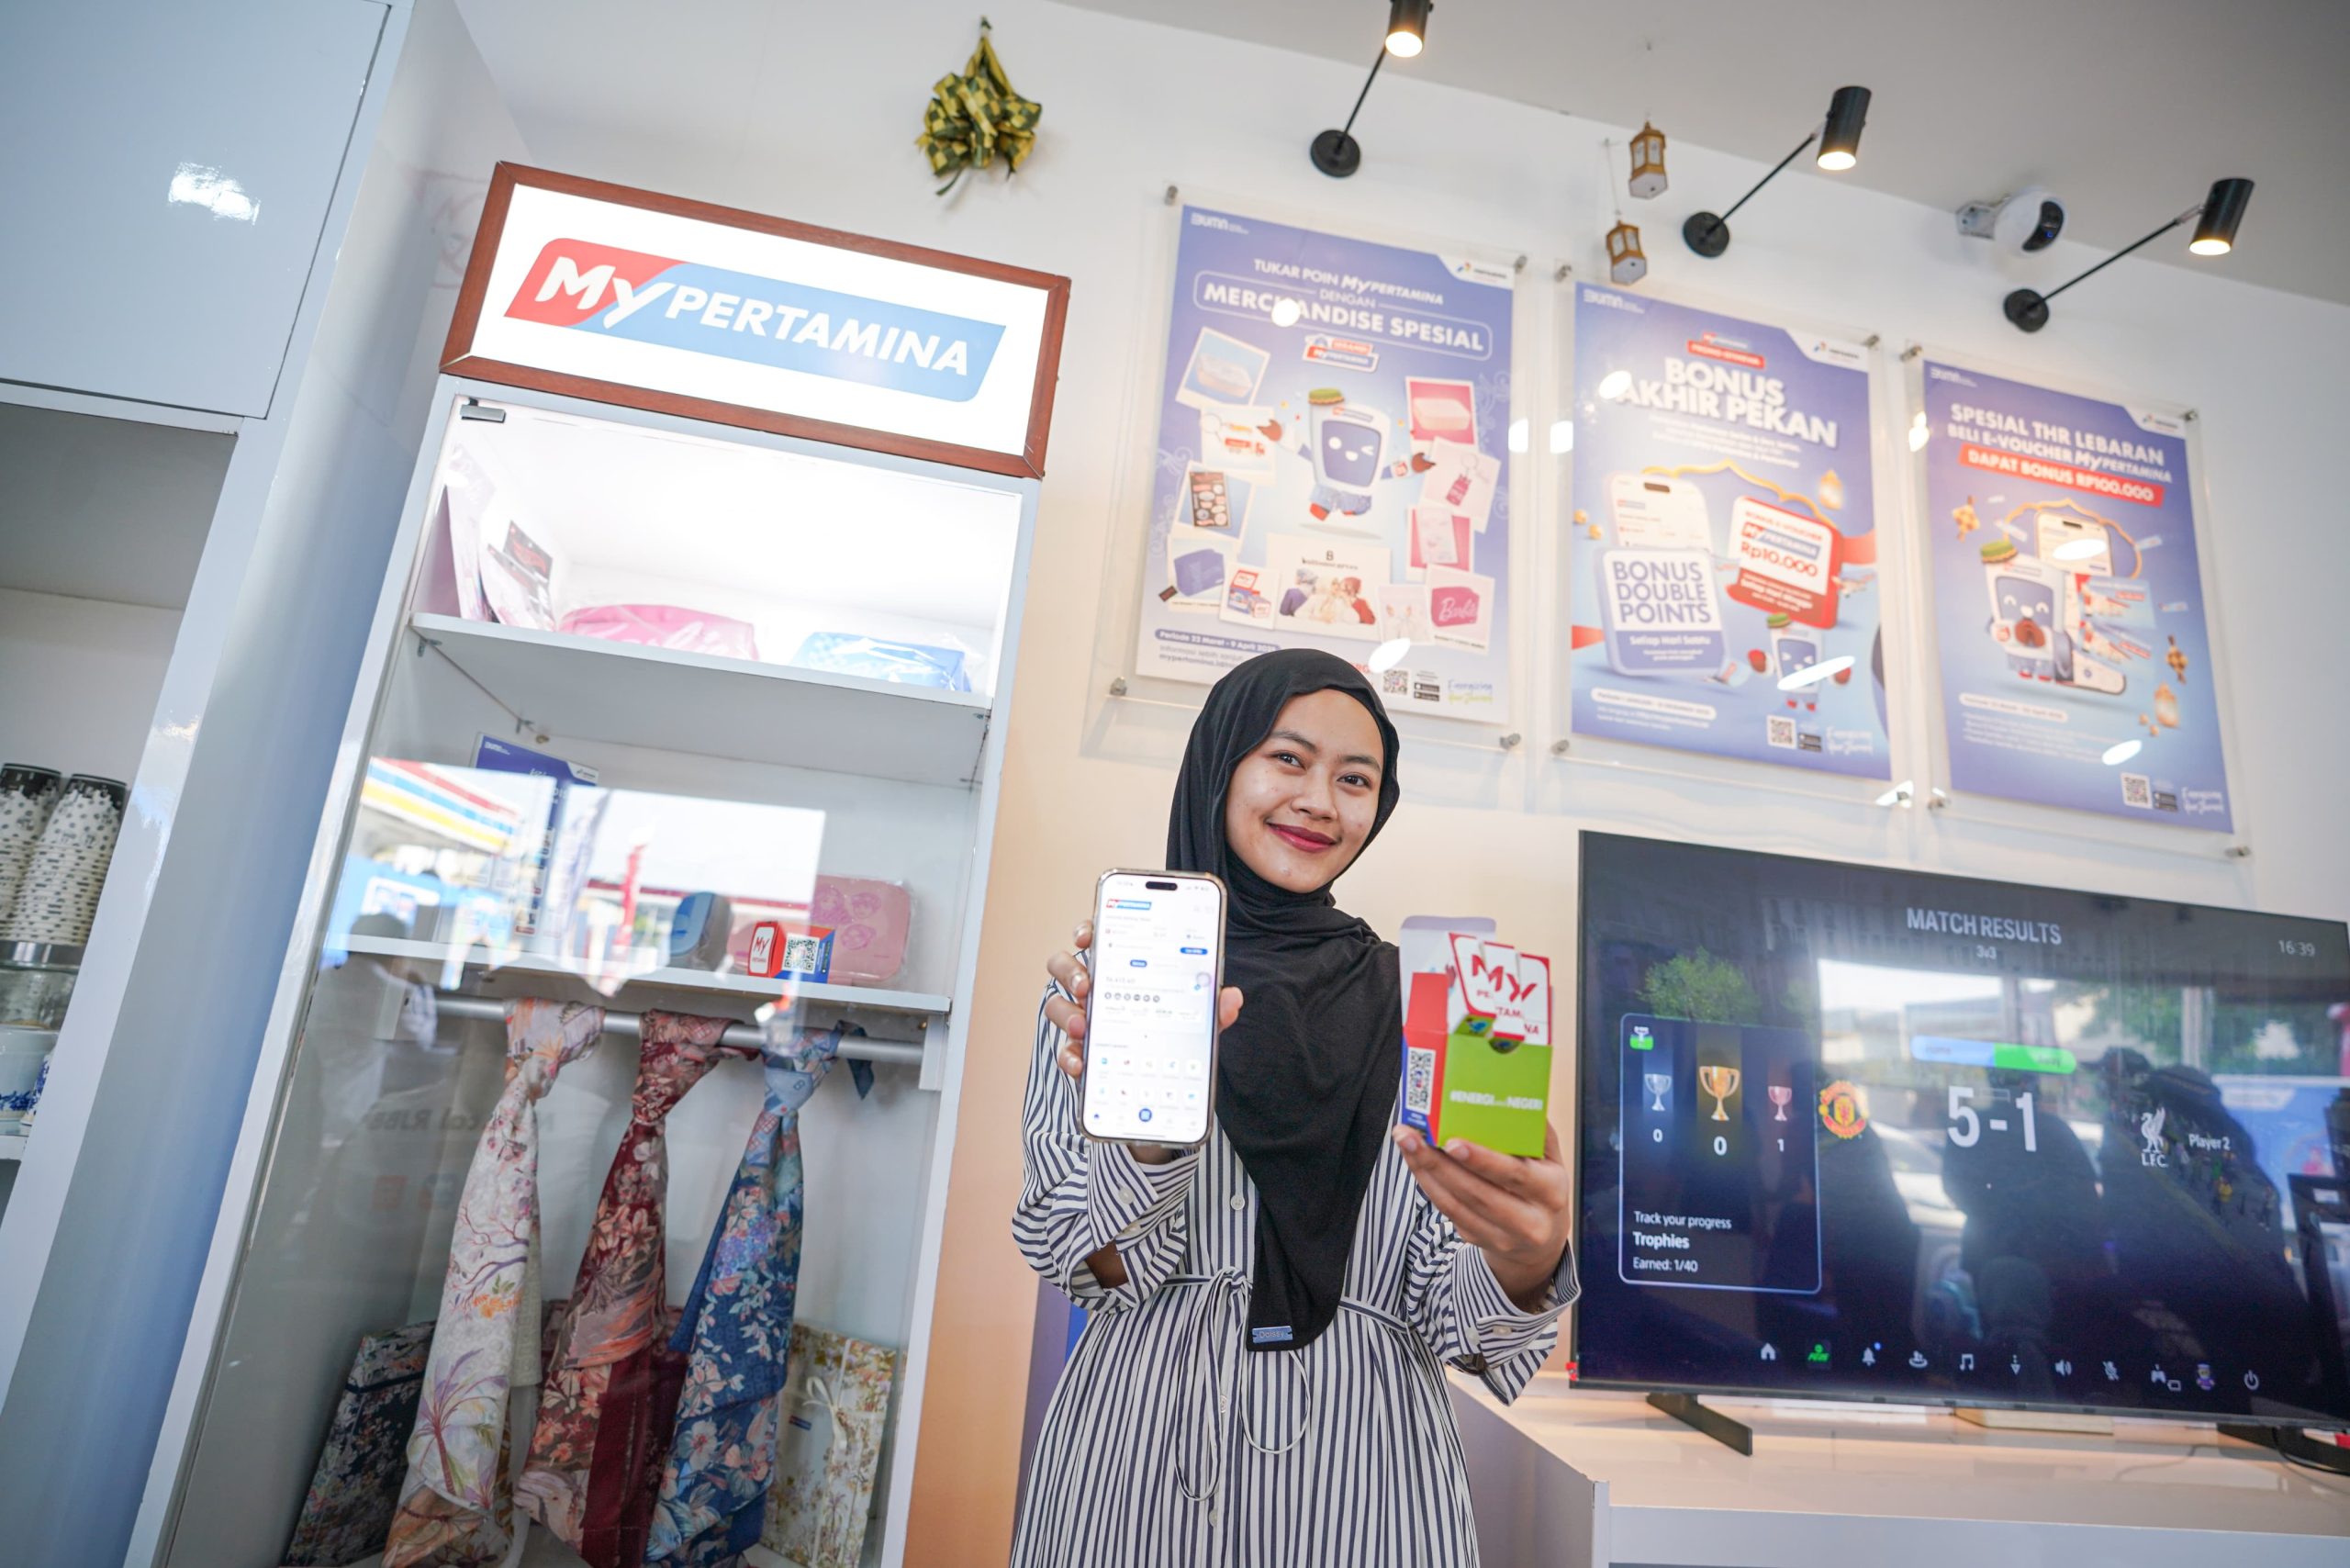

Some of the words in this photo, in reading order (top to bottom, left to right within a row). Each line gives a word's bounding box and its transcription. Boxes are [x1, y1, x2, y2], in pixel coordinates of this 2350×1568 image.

[1254, 259, 1300, 279] TUKAR
[1302, 269, 1339, 286] POIN
[1319, 288, 1376, 308] DENGAN
[1203, 283, 1383, 332] MERCANDISE
[1389, 317, 1484, 352] SPESIAL
[1663, 357, 1786, 406] BONUS
[1617, 377, 1721, 420] AKHIR
[1727, 395, 1838, 449] PEKAN
[1947, 422, 1980, 442] BELI
[1982, 431, 2073, 464] E-VOUCHER
[1951, 403, 2030, 436] SPESIAL
[2031, 420, 2072, 446] THR
[2075, 431, 2165, 466] LEBARAN
[1967, 449, 2019, 474] DAPAT
[2020, 462, 2074, 486] BONUS
[1740, 541, 1818, 577] Rp10.000
[1612, 560, 1703, 582] BONUS
[1616, 583, 1707, 601] DOUBLE
[1619, 602, 1712, 623] POINTS
[1907, 907, 1977, 936] MATCH
[1980, 916, 2063, 946] RESULTS
[1652, 1128, 1663, 1143] 0
[1713, 1136, 1728, 1156] 0
[1777, 1138, 1785, 1152] 1
[2188, 1132, 2221, 1151] Player
[2221, 1136, 2231, 1151] 2
[1634, 1211, 1662, 1225] Track
[1662, 1215, 1686, 1226] your
[1687, 1216, 1732, 1230] progress
[1632, 1231, 1690, 1250] Trophies
[1633, 1256, 1672, 1271] Earned:
[1673, 1259, 1699, 1272] 1/40
